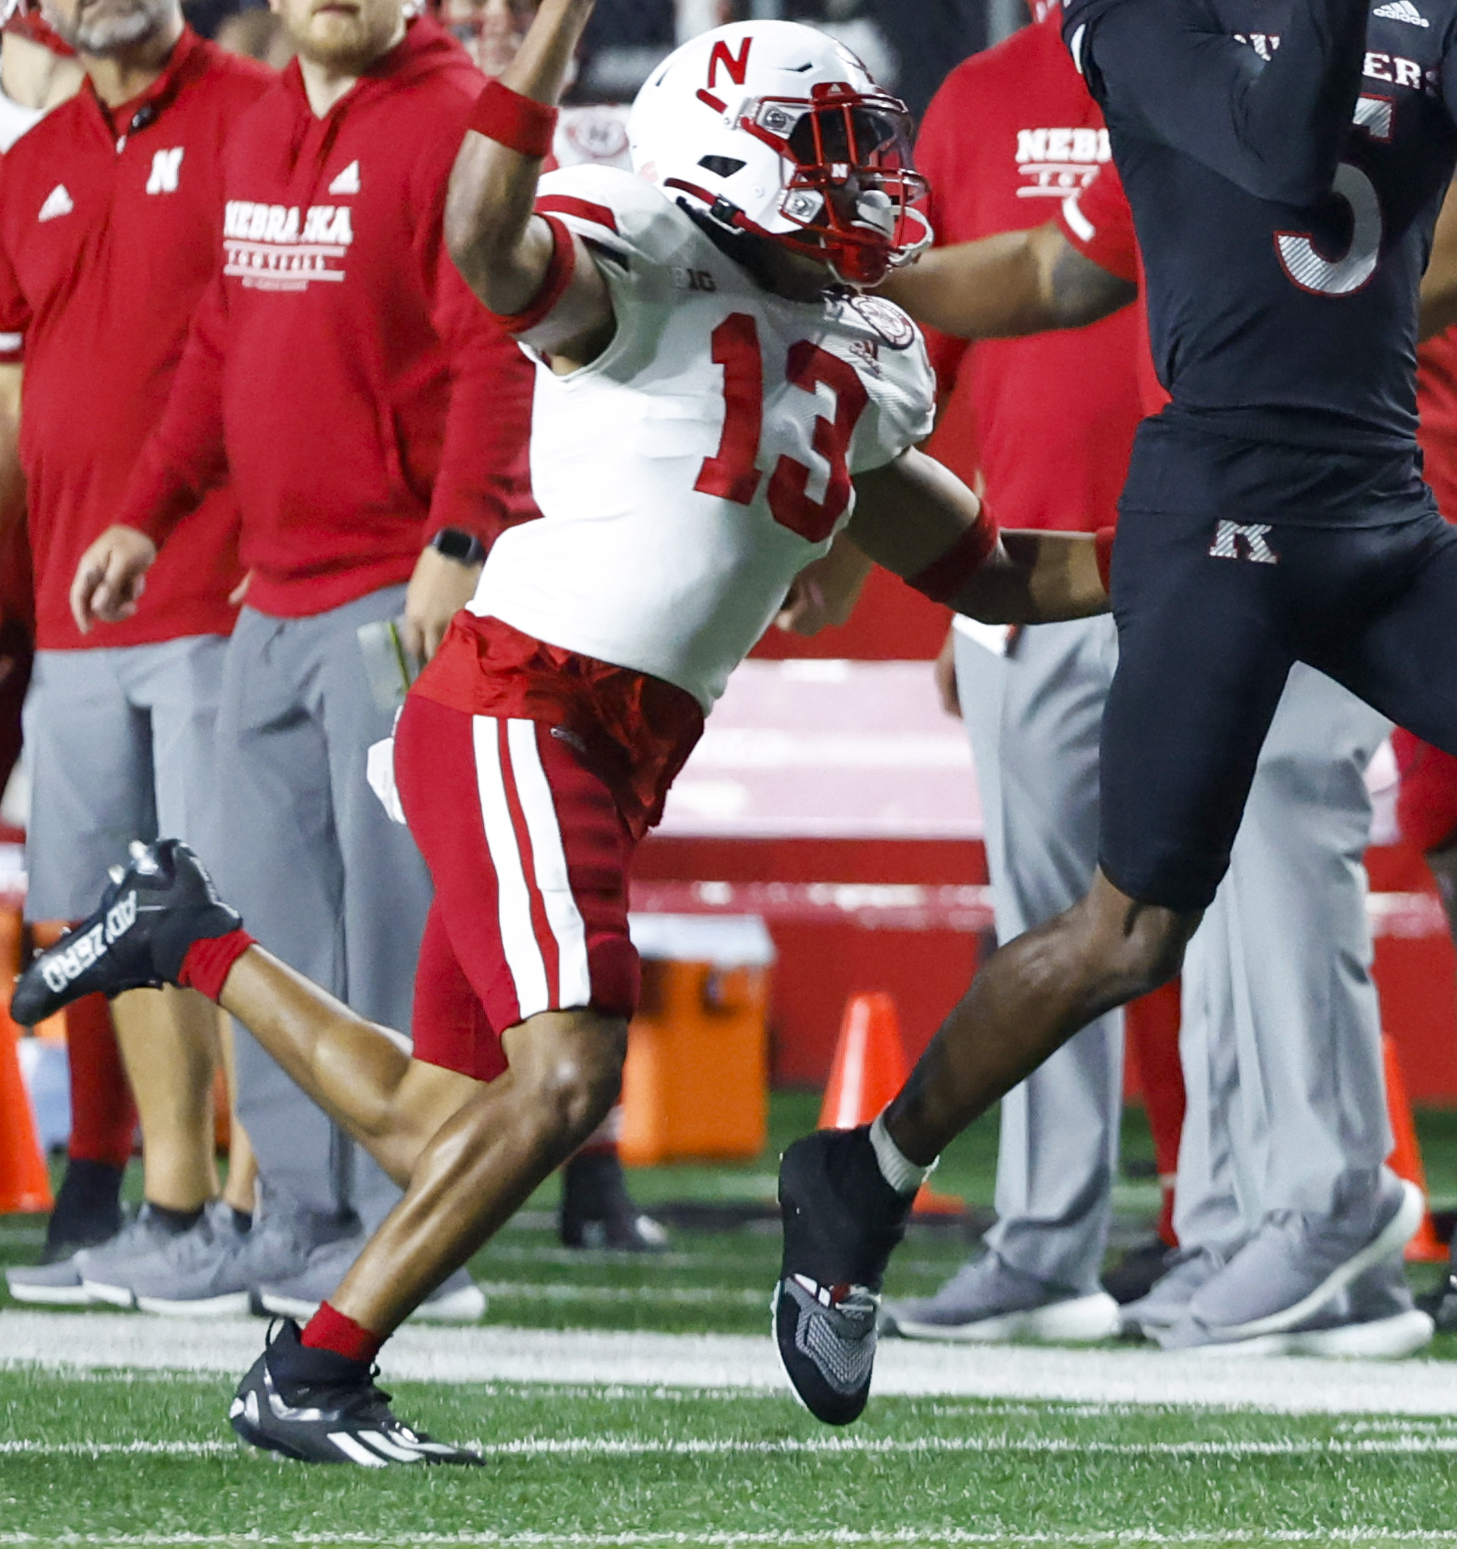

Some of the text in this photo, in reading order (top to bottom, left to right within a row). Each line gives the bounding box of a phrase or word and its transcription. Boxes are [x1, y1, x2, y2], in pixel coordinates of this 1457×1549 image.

[1372, 8, 1430, 28] adidas
[707, 36, 754, 89] N
[146, 146, 185, 196] N
[223, 199, 354, 245] NEBRASKA
[693, 311, 868, 544] 13
